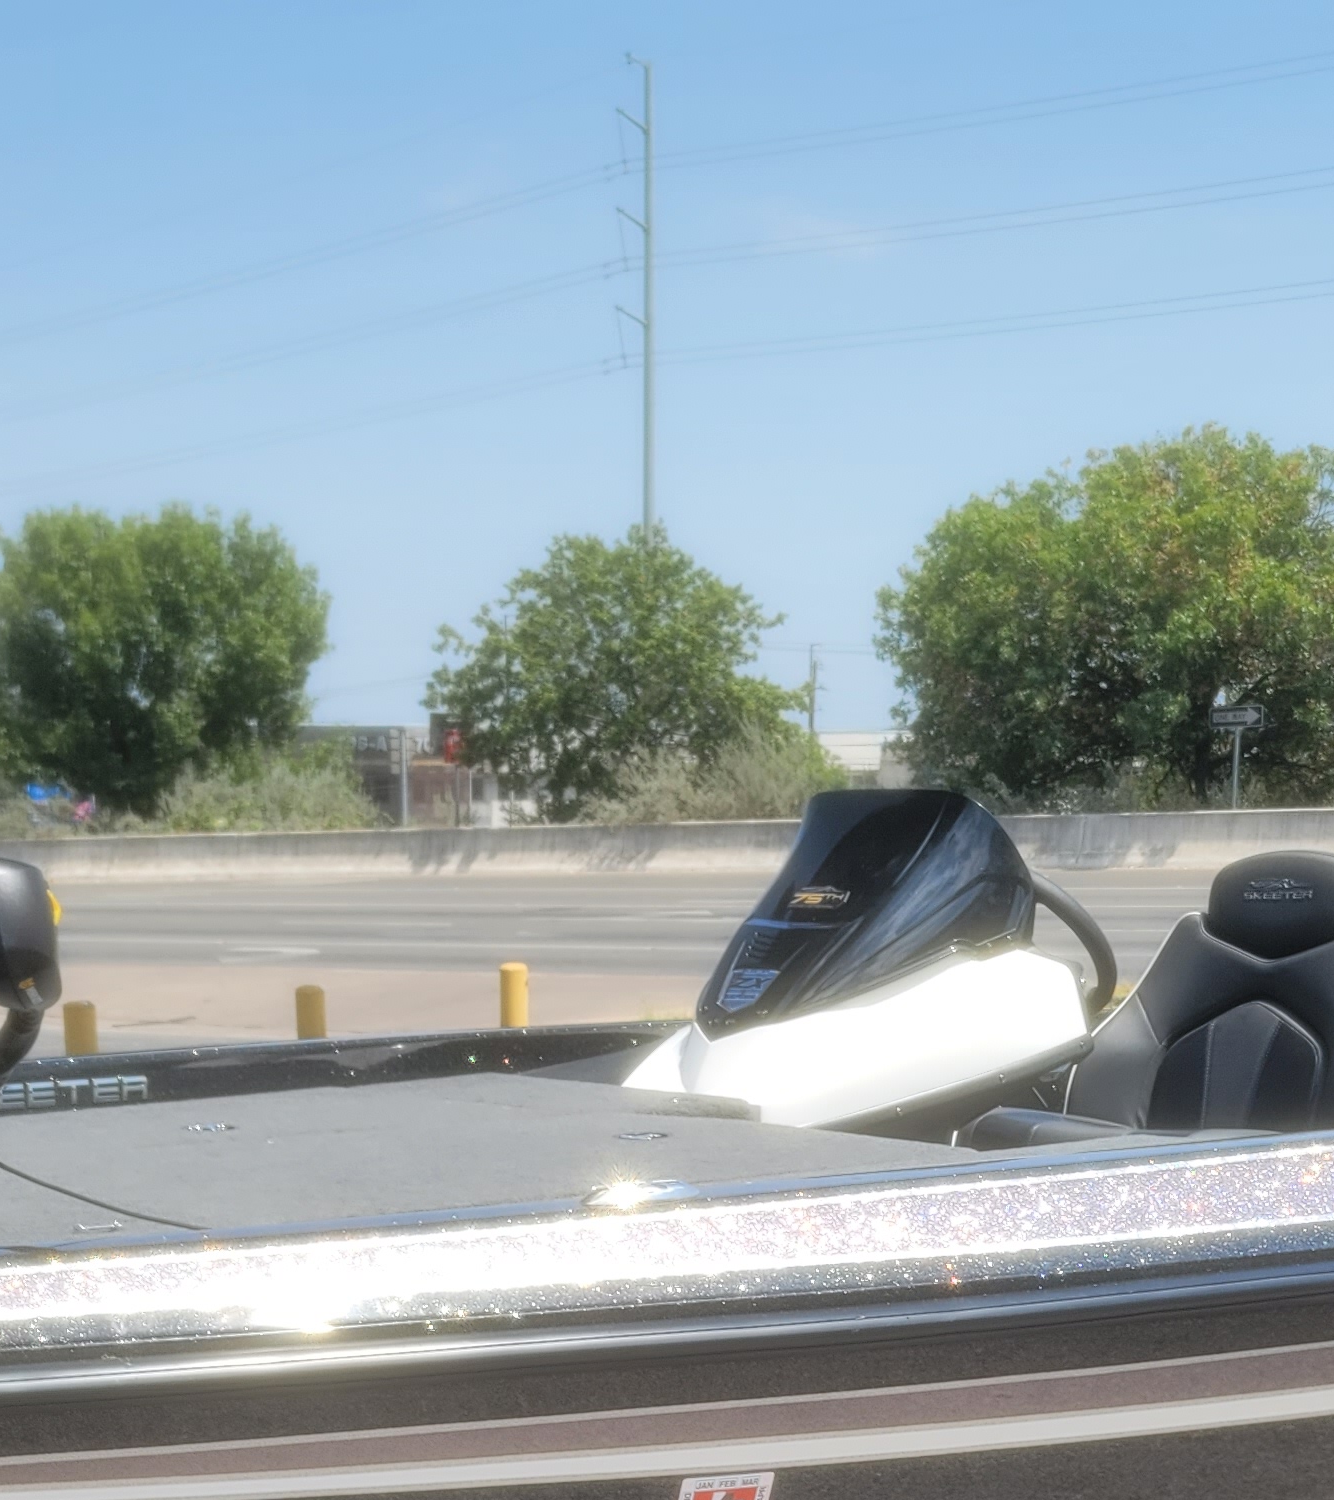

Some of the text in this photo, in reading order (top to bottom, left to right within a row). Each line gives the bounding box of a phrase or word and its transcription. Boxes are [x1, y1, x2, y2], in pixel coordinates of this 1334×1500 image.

[1243, 890, 1314, 900] SKEETER
[695, 1477, 759, 1490] JAN FEB MAR
